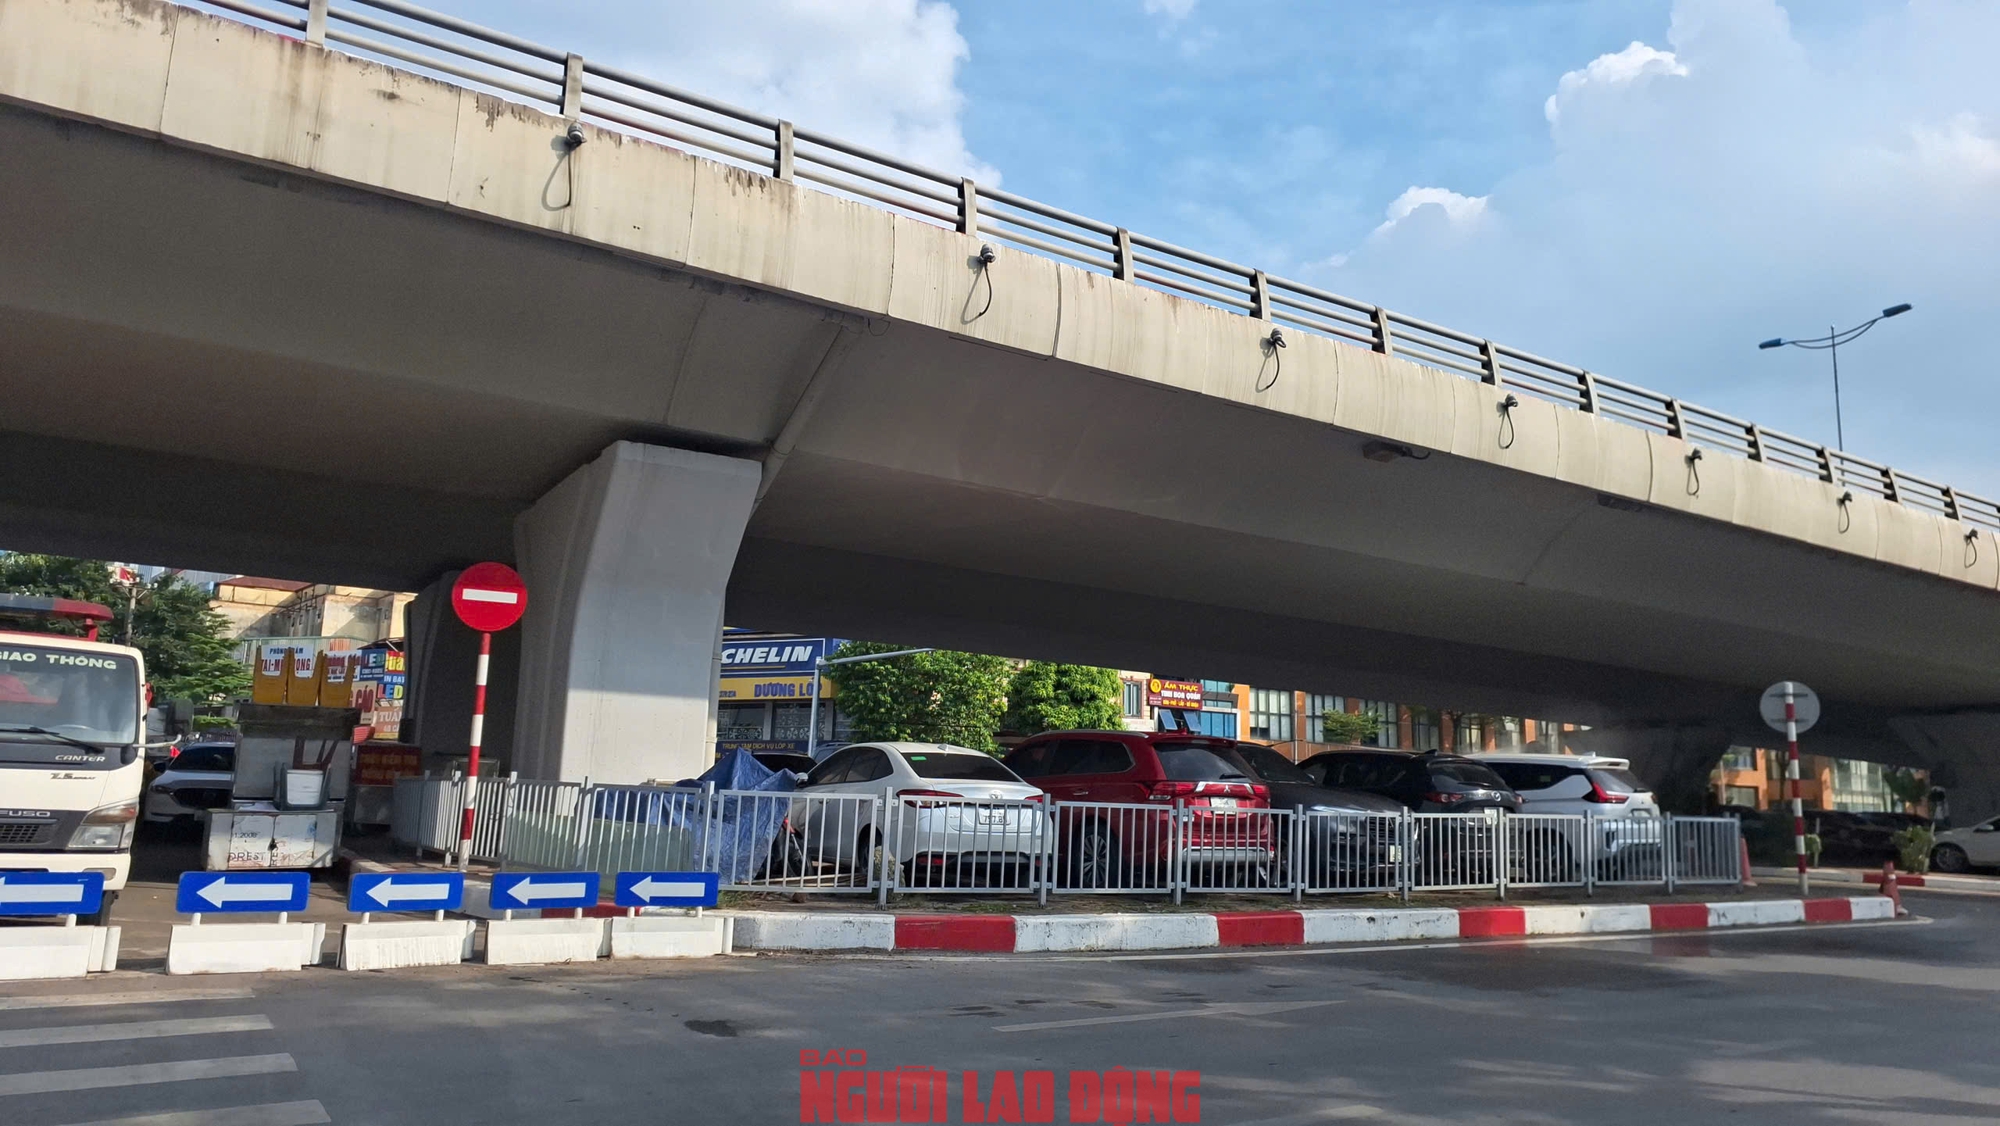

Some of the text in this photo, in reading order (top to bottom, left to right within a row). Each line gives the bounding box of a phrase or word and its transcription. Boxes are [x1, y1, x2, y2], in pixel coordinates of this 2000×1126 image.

[0, 651, 117, 670] IAO THÔNG
[377, 684, 404, 699] LED
[55, 754, 106, 762] CANTER
